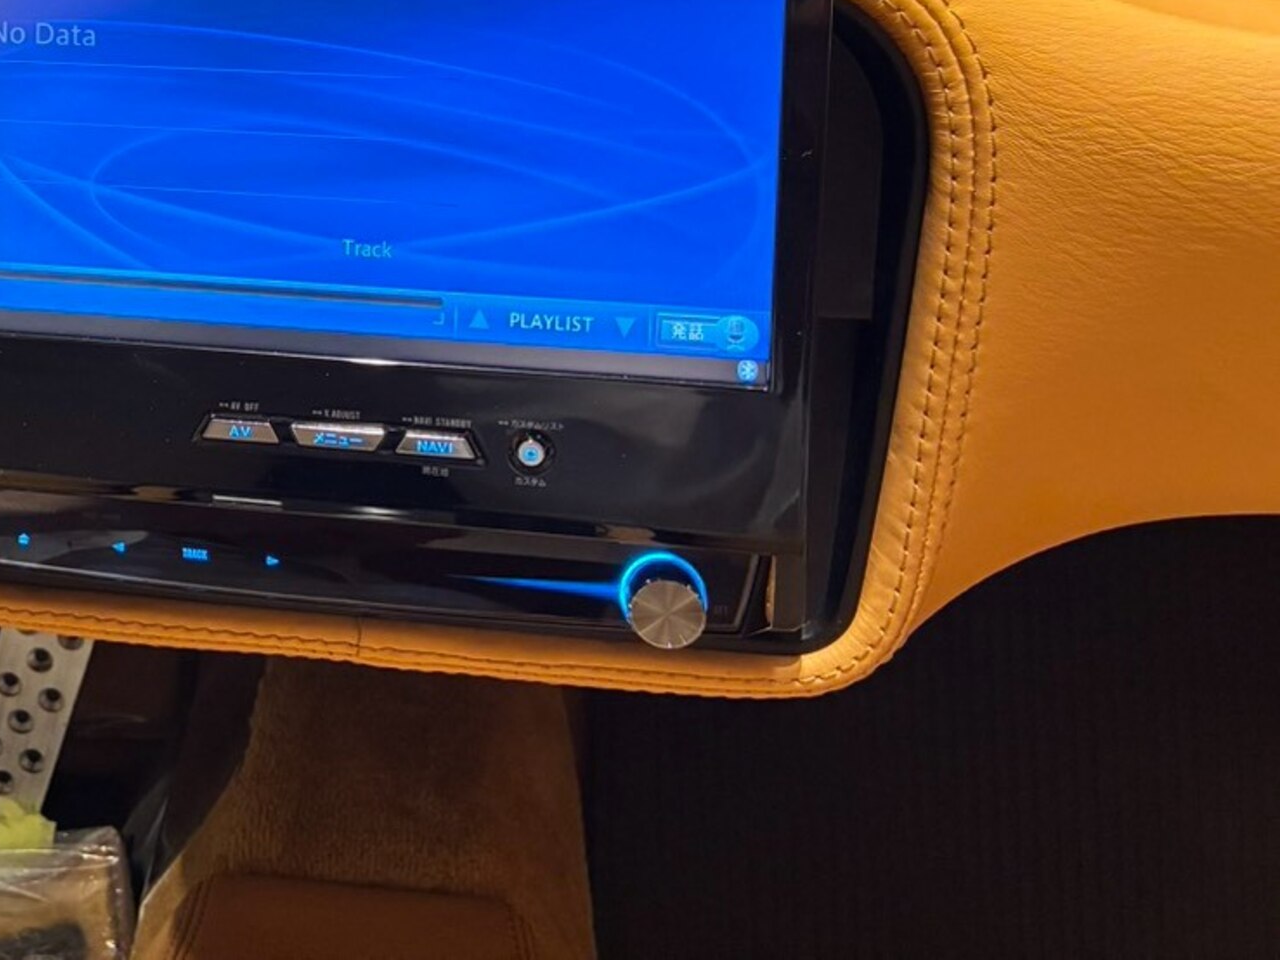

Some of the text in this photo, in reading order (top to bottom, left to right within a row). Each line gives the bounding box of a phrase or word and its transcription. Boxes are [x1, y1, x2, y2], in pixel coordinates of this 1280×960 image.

[35, 23, 96, 46] Data
[342, 239, 392, 259] Track
[509, 313, 595, 333] PLAYLIST
[229, 424, 251, 439] AV
[313, 432, 363, 447] メニュー
[417, 439, 453, 454] NAVI
